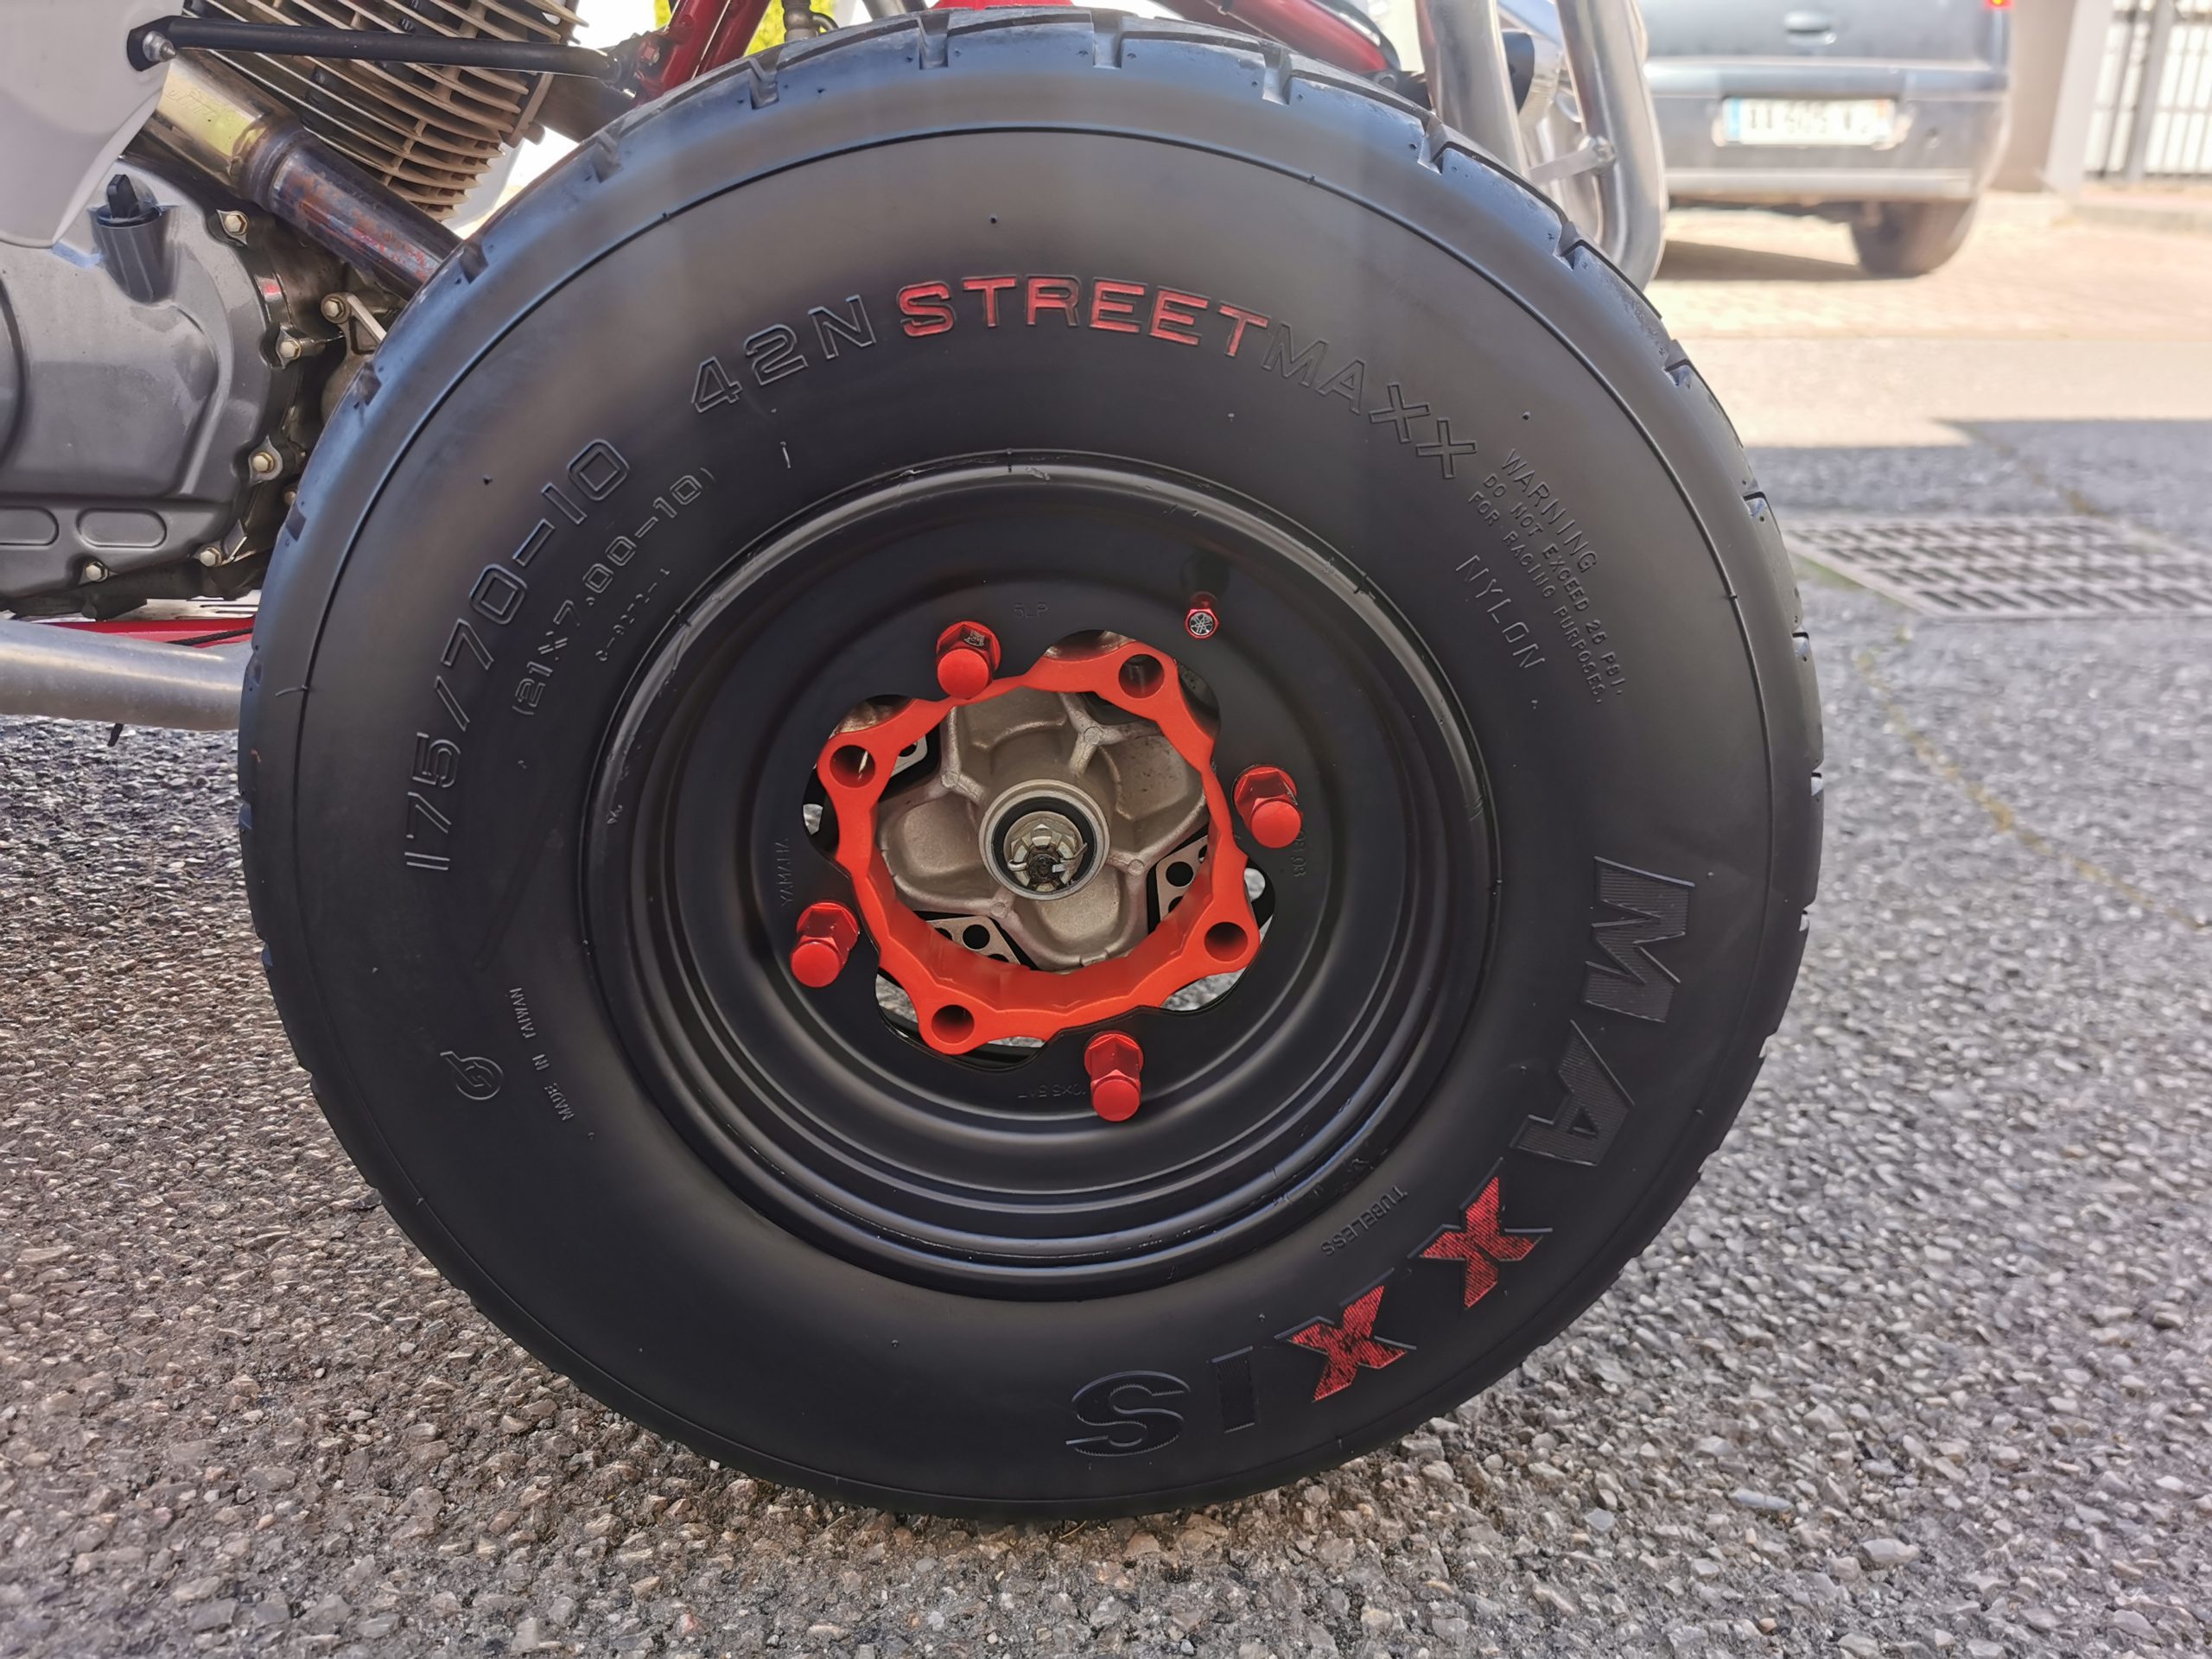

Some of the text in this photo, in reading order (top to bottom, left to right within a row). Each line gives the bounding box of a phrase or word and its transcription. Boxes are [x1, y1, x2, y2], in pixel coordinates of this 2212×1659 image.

[1468, 490, 1501, 526] FOR
[1503, 530, 1556, 599] RACING
[1483, 473, 1508, 499] DO
[1510, 501, 1543, 537] NOT
[1542, 543, 1590, 613] EXCEED
[1501, 448, 1599, 574] WARNING
[403, 438, 632, 871] 175/70-10
[690, 293, 877, 414] 42N
[1454, 554, 1546, 670] NYLON
[509, 987, 575, 1122] MADE IN TAIWAN
[1065, 854, 1697, 1458] MAXXIS
[1320, 1185, 1409, 1256] TUBELESS
